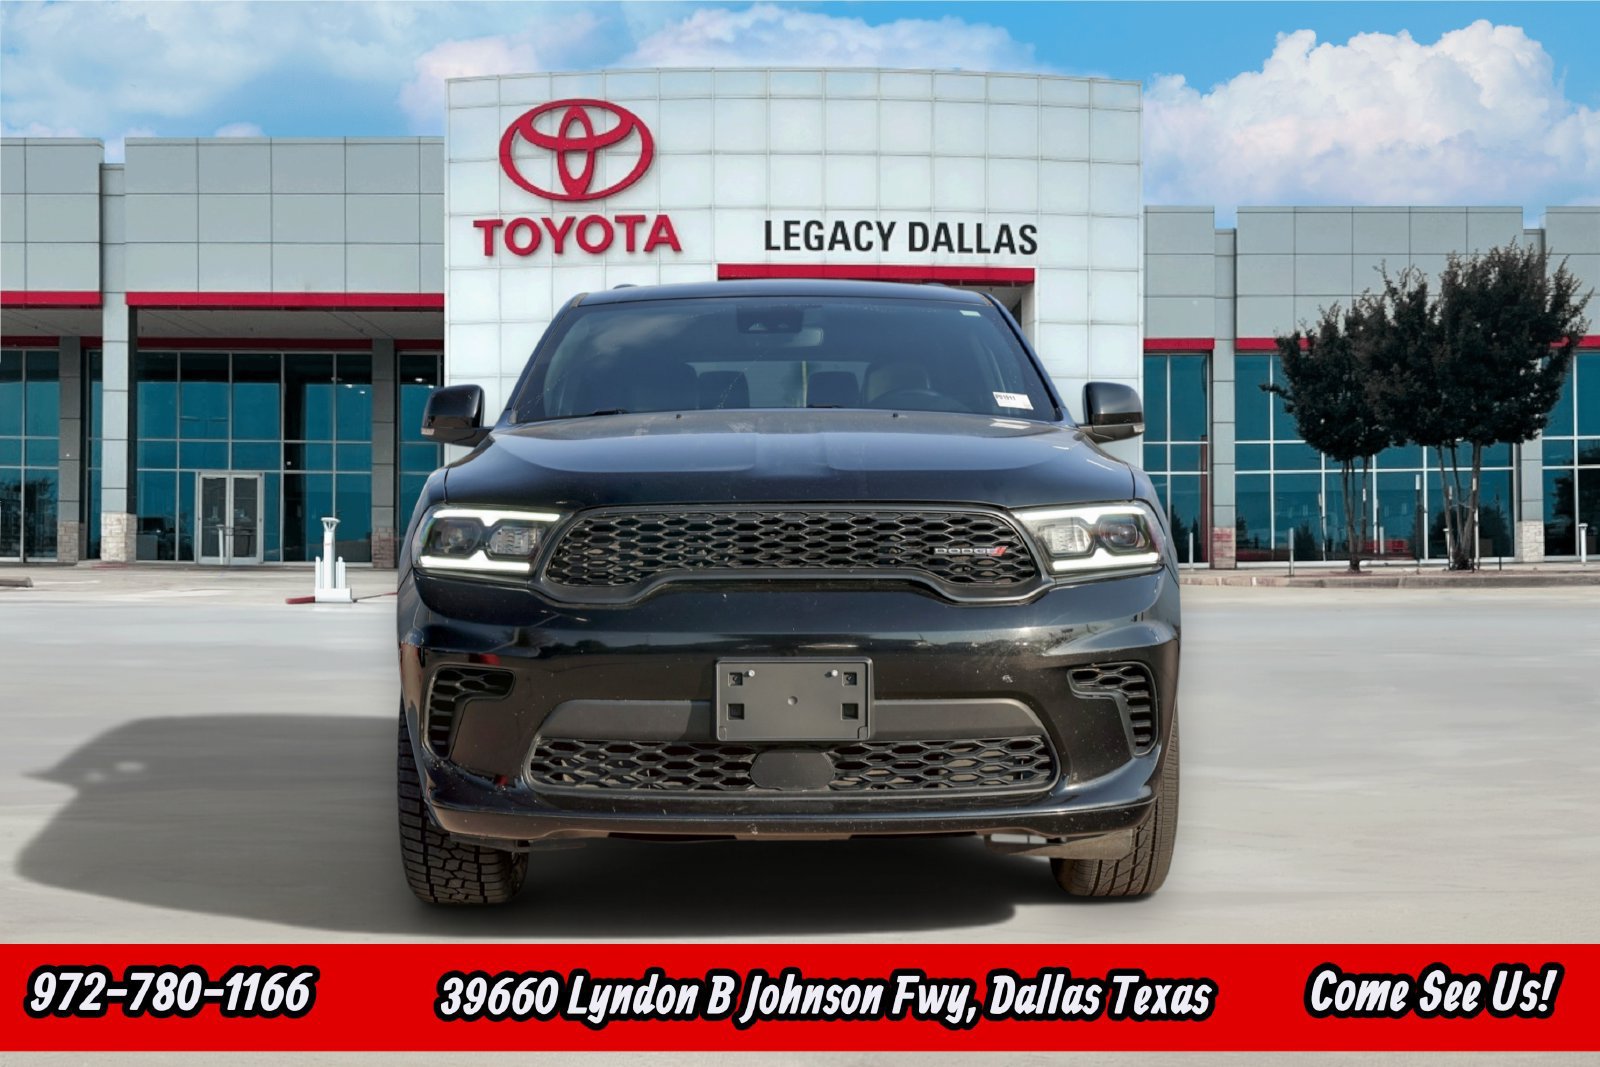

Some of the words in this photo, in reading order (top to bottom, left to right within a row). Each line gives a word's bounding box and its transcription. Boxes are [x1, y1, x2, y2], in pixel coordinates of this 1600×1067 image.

[474, 214, 681, 257] TOYOTA
[764, 220, 897, 252] LEGACY
[908, 221, 1038, 256] DALLAS
